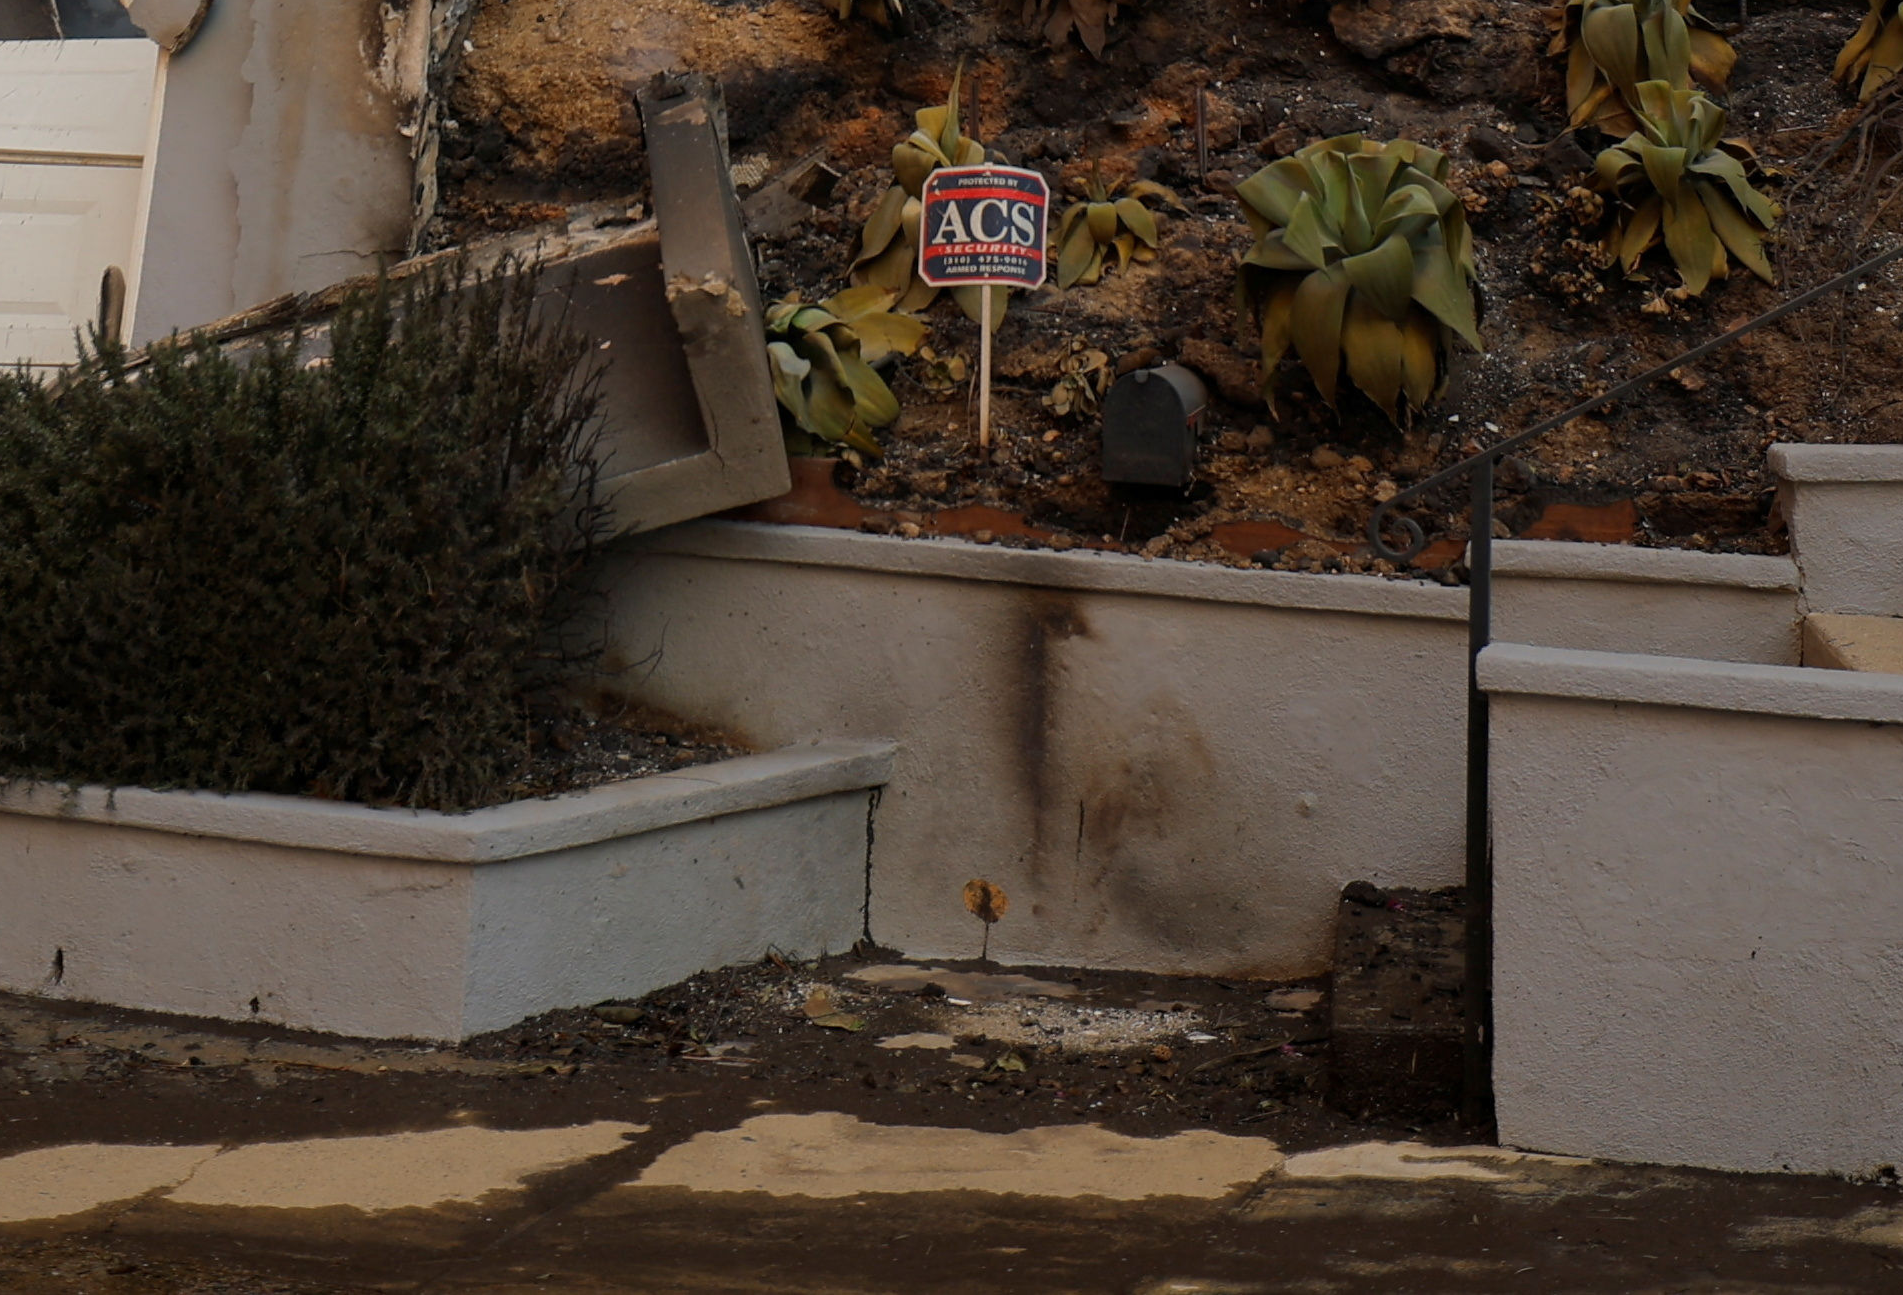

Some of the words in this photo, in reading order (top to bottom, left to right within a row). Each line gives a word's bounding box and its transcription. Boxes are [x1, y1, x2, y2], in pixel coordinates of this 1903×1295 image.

[958, 178, 1006, 186] PROTECTED
[1007, 178, 1018, 187] BY
[931, 198, 1035, 247] ACS
[944, 244, 1027, 255] SECURITY
[943, 256, 970, 265] (310)
[945, 265, 977, 274] ARMED
[979, 265, 1026, 275] RESPONSE
